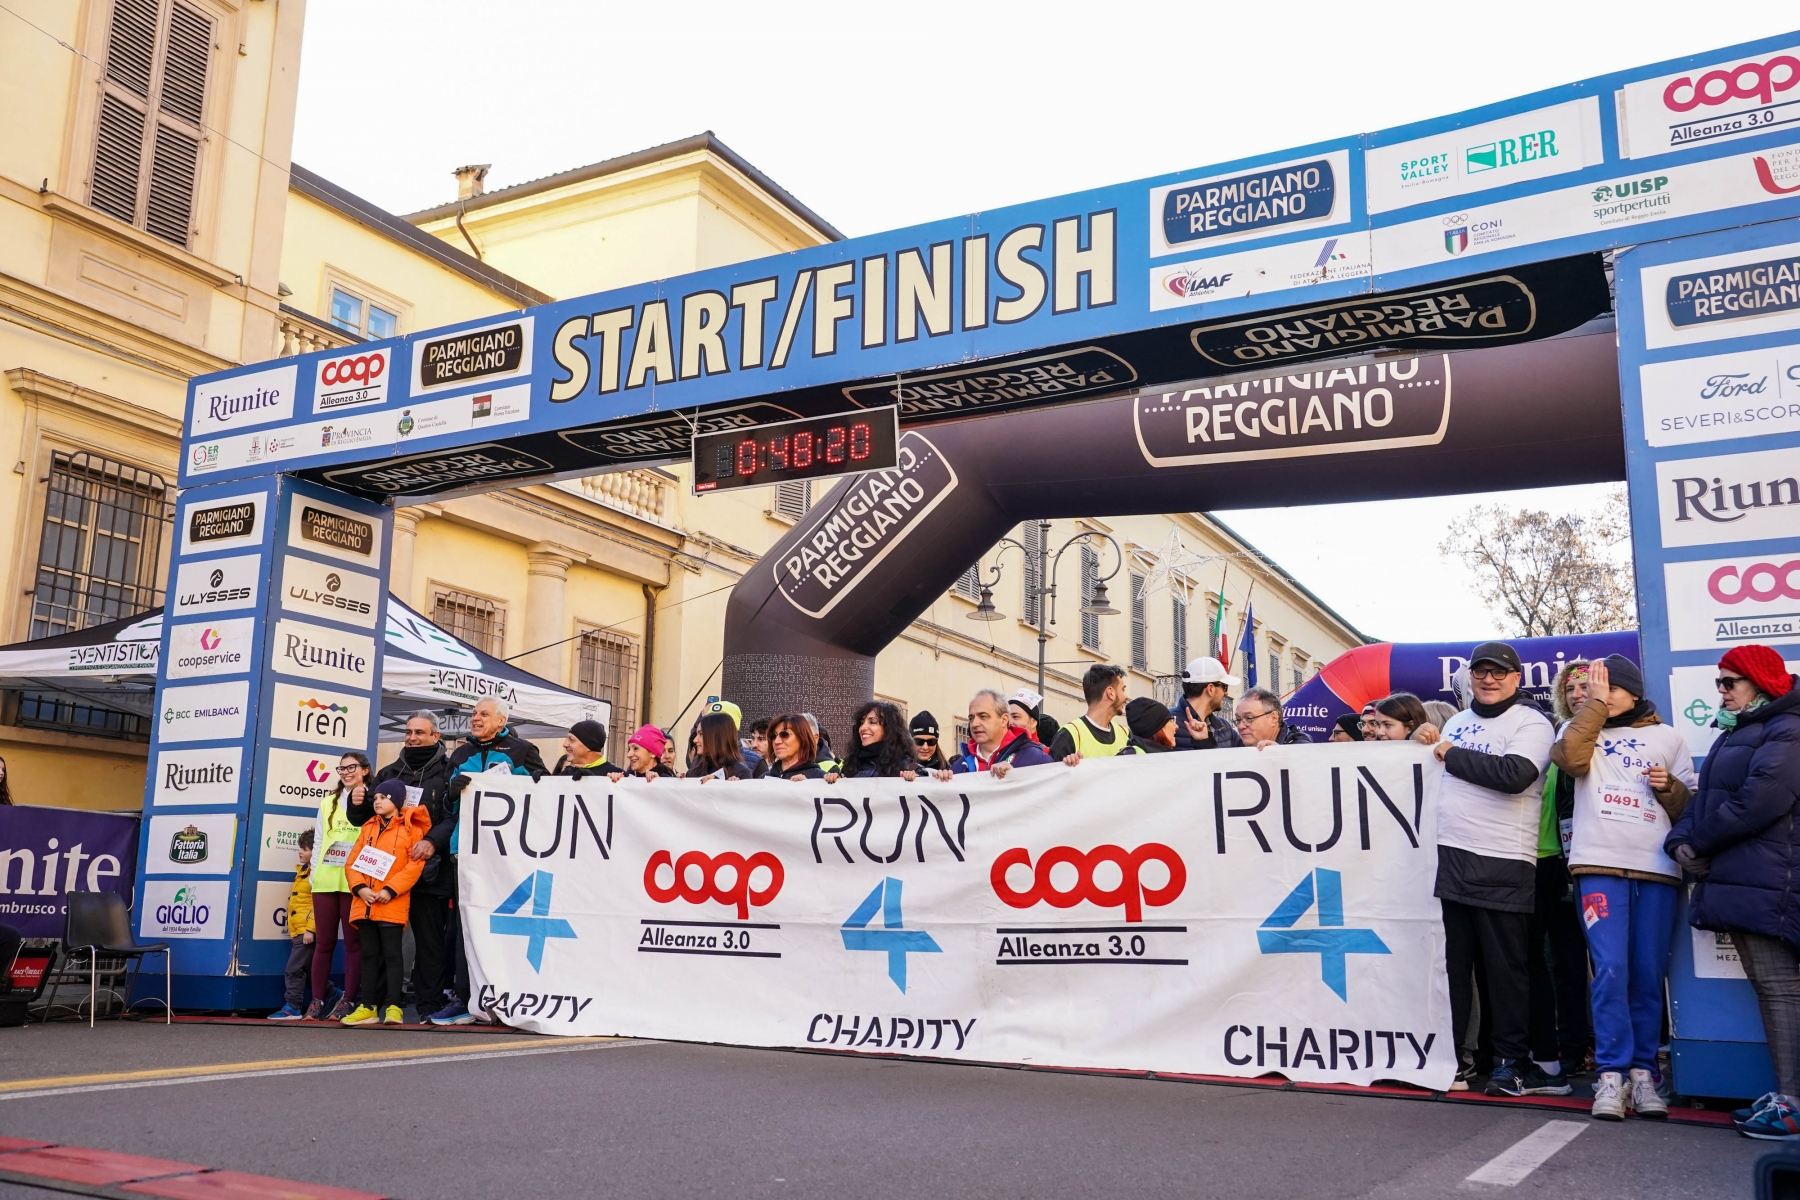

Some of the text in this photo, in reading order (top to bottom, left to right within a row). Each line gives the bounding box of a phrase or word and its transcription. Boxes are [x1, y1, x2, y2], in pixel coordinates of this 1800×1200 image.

[1663, 56, 1800, 113] coop
[1670, 110, 1775, 142] Alleanza 3.0
[1401, 153, 1448, 171] SPORT
[1401, 164, 1449, 180] VALLEY
[1176, 167, 1320, 214] PARMIGIANO
[1615, 176, 1669, 198] UISP
[1190, 193, 1306, 234] REGGIANO
[1593, 193, 1671, 219] sportpertutti
[1446, 228, 1467, 237] ITALIA
[1472, 219, 1503, 232] CONI
[1190, 273, 1233, 292] IAAF
[1290, 262, 1372, 280] FEDERAZINE ITALIANA
[1337, 269, 1369, 279] LEGGERA
[1678, 261, 1800, 300] PARMIGIA
[549, 207, 1118, 404] START/FINISH
[1245, 293, 1472, 344] REGGIANO
[429, 330, 515, 362] PARMIGIANO
[1233, 306, 1507, 360] PARMIGIANO
[320, 353, 385, 386] coop
[436, 350, 506, 379] REGGIANO
[320, 390, 369, 407] Alleanza 3.0
[1700, 373, 1768, 400] Ford
[207, 387, 280, 421] Riunite
[1186, 388, 1394, 444] REGGIANO
[739, 424, 870, 475] 0:48:20
[195, 506, 251, 526] PARMIGIANO
[199, 519, 244, 538] REGGIANO
[307, 510, 368, 538] PARMIGIANO
[312, 523, 362, 549] REGGIANO
[812, 477, 925, 590] REGGIANO
[179, 587, 252, 607] ULYSSES
[289, 586, 371, 614] ULYSSES
[1716, 622, 1792, 637] Alleanza
[178, 652, 241, 669] coopservice
[284, 633, 366, 673] Riunite
[175, 707, 240, 719] BCC EMILBANCA
[296, 710, 347, 737] iren
[1282, 703, 1329, 719] iunite
[164, 763, 234, 791] Riunite
[1213, 763, 1424, 855] RUN
[1603, 793, 1640, 808] 0491
[472, 791, 614, 860] RUN
[811, 793, 971, 864] RUN
[173, 839, 206, 850] Fattoria
[177, 850, 199, 861] Italia
[643, 850, 785, 920] coop
[990, 842, 1187, 923] coop
[156, 905, 209, 924] GIGLIO
[489, 869, 578, 975] 4
[640, 926, 750, 950] Alleanza 3.0
[840, 876, 944, 996] 4
[997, 935, 1146, 958] Alleanza 3.0
[1256, 867, 1393, 1004] 4
[806, 1013, 977, 1051] CHARITY
[1224, 1025, 1437, 1071] CHARITY
